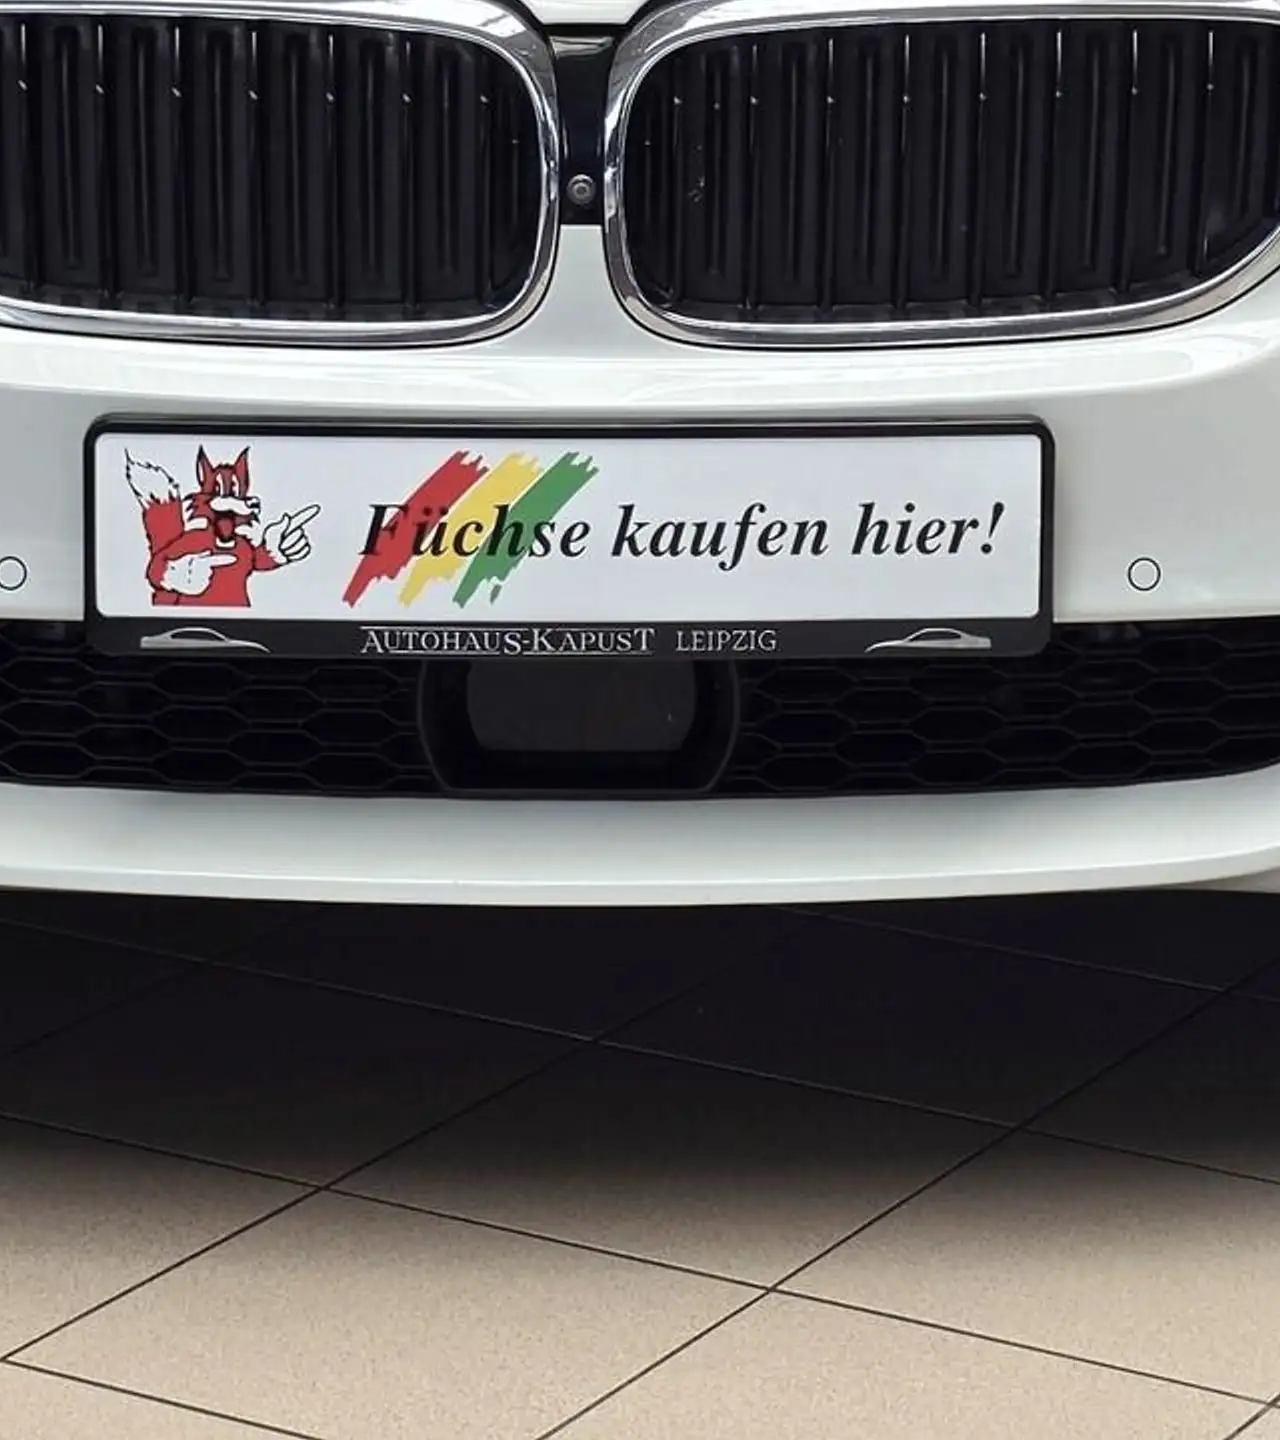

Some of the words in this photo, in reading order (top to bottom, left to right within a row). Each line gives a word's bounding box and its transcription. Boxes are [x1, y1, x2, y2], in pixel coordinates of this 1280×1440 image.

[360, 504, 590, 557] Füchse
[611, 502, 829, 571] kaufen
[851, 502, 1005, 555] hier!
[361, 627, 655, 655] AUTOHAUS-KAPUST
[676, 630, 777, 652] LEIPZIG
